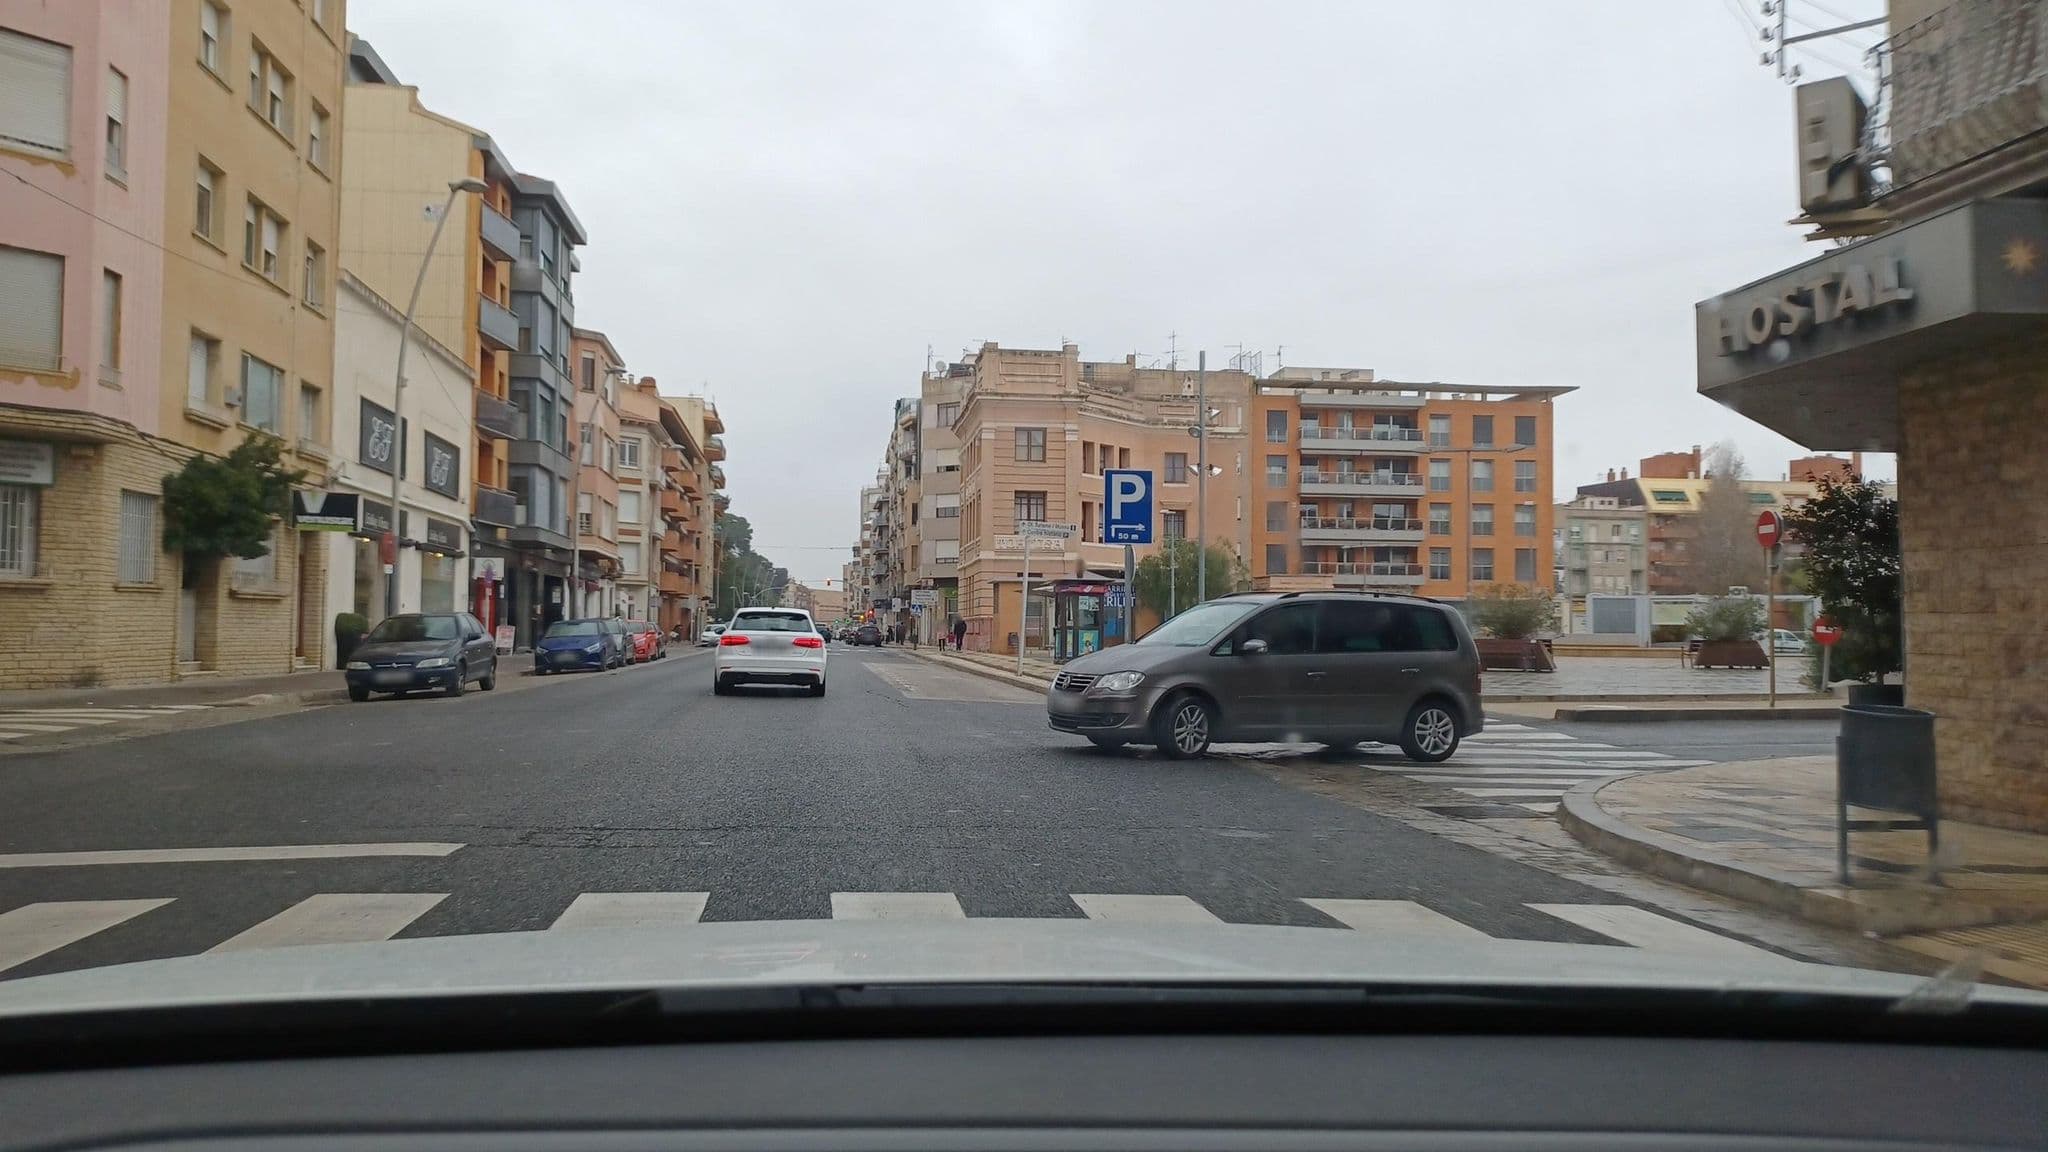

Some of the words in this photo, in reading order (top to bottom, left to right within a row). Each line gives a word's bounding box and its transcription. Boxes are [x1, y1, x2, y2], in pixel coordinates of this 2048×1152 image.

[1718, 256, 1914, 356] HOSTAL
[1111, 474, 1146, 519] P
[1118, 532, 1129, 540] 50
